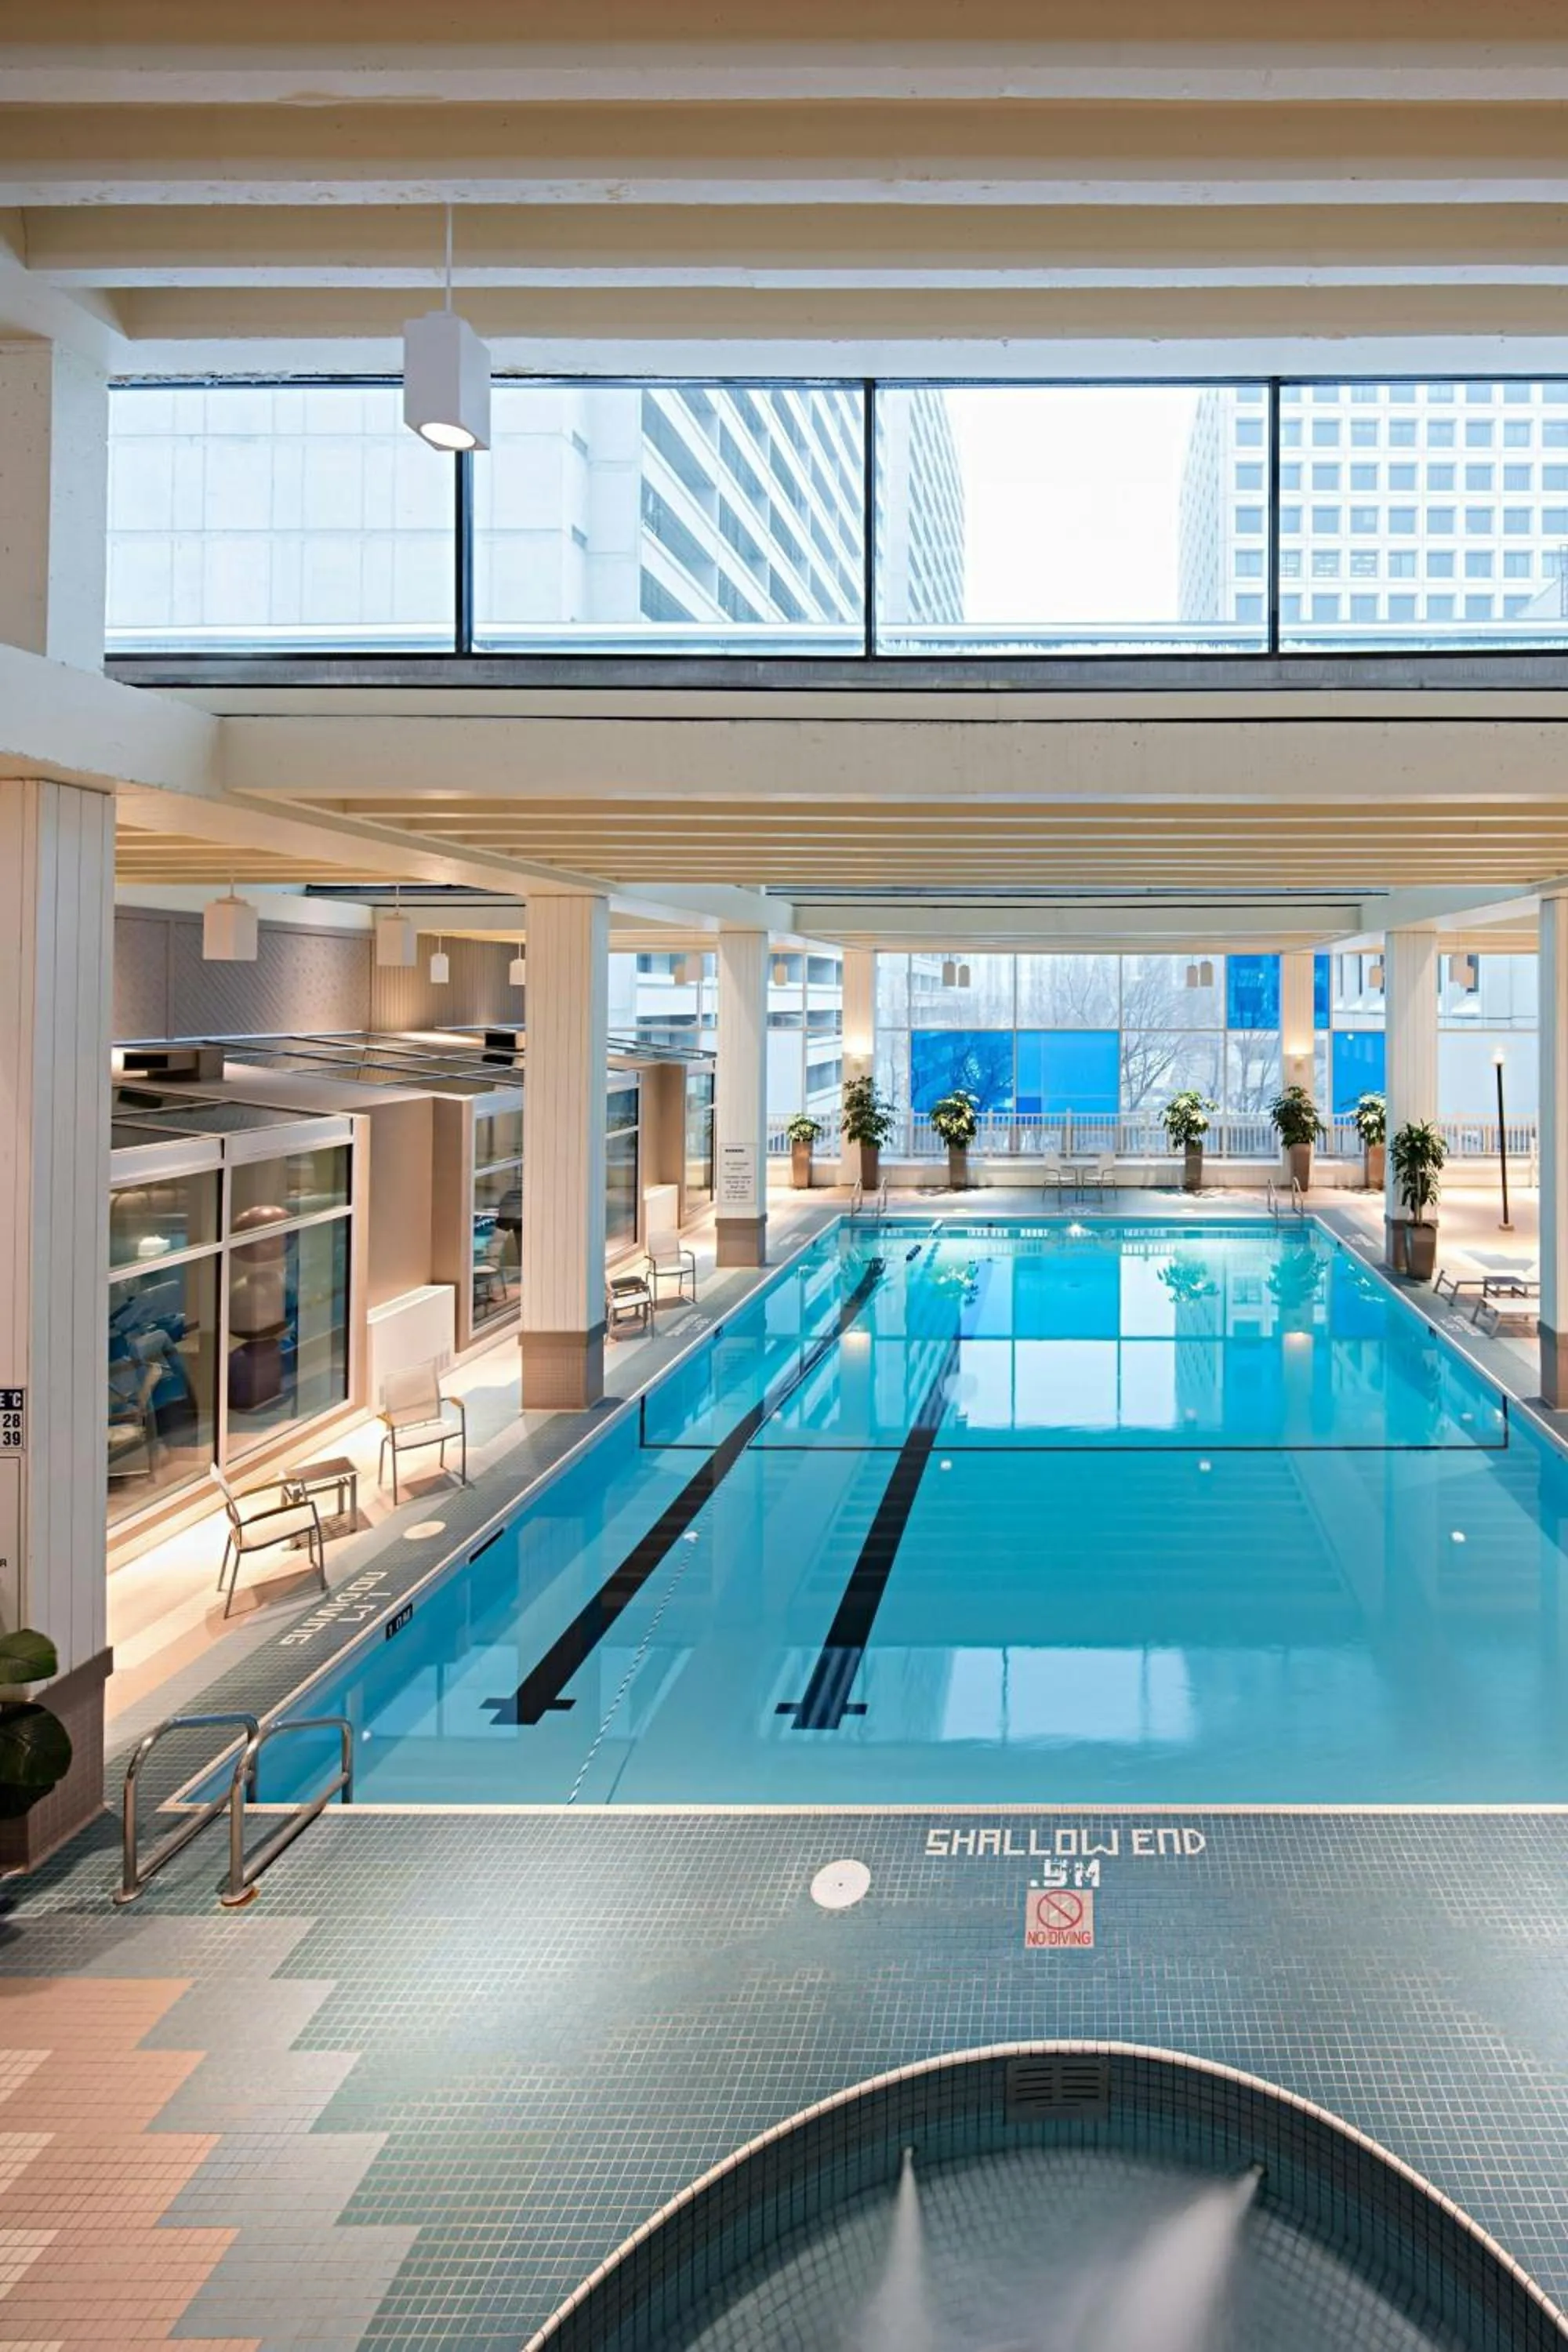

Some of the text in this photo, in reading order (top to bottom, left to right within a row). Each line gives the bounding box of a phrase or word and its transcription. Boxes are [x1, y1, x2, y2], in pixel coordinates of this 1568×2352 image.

[2, 1414, 20, 1428] 28
[2, 1431, 20, 1446] 39
[279, 1592, 363, 1644] DIVING
[924, 1828, 1207, 1856] SHALLOW END
[1028, 1930, 1091, 1945] NO DIVING
